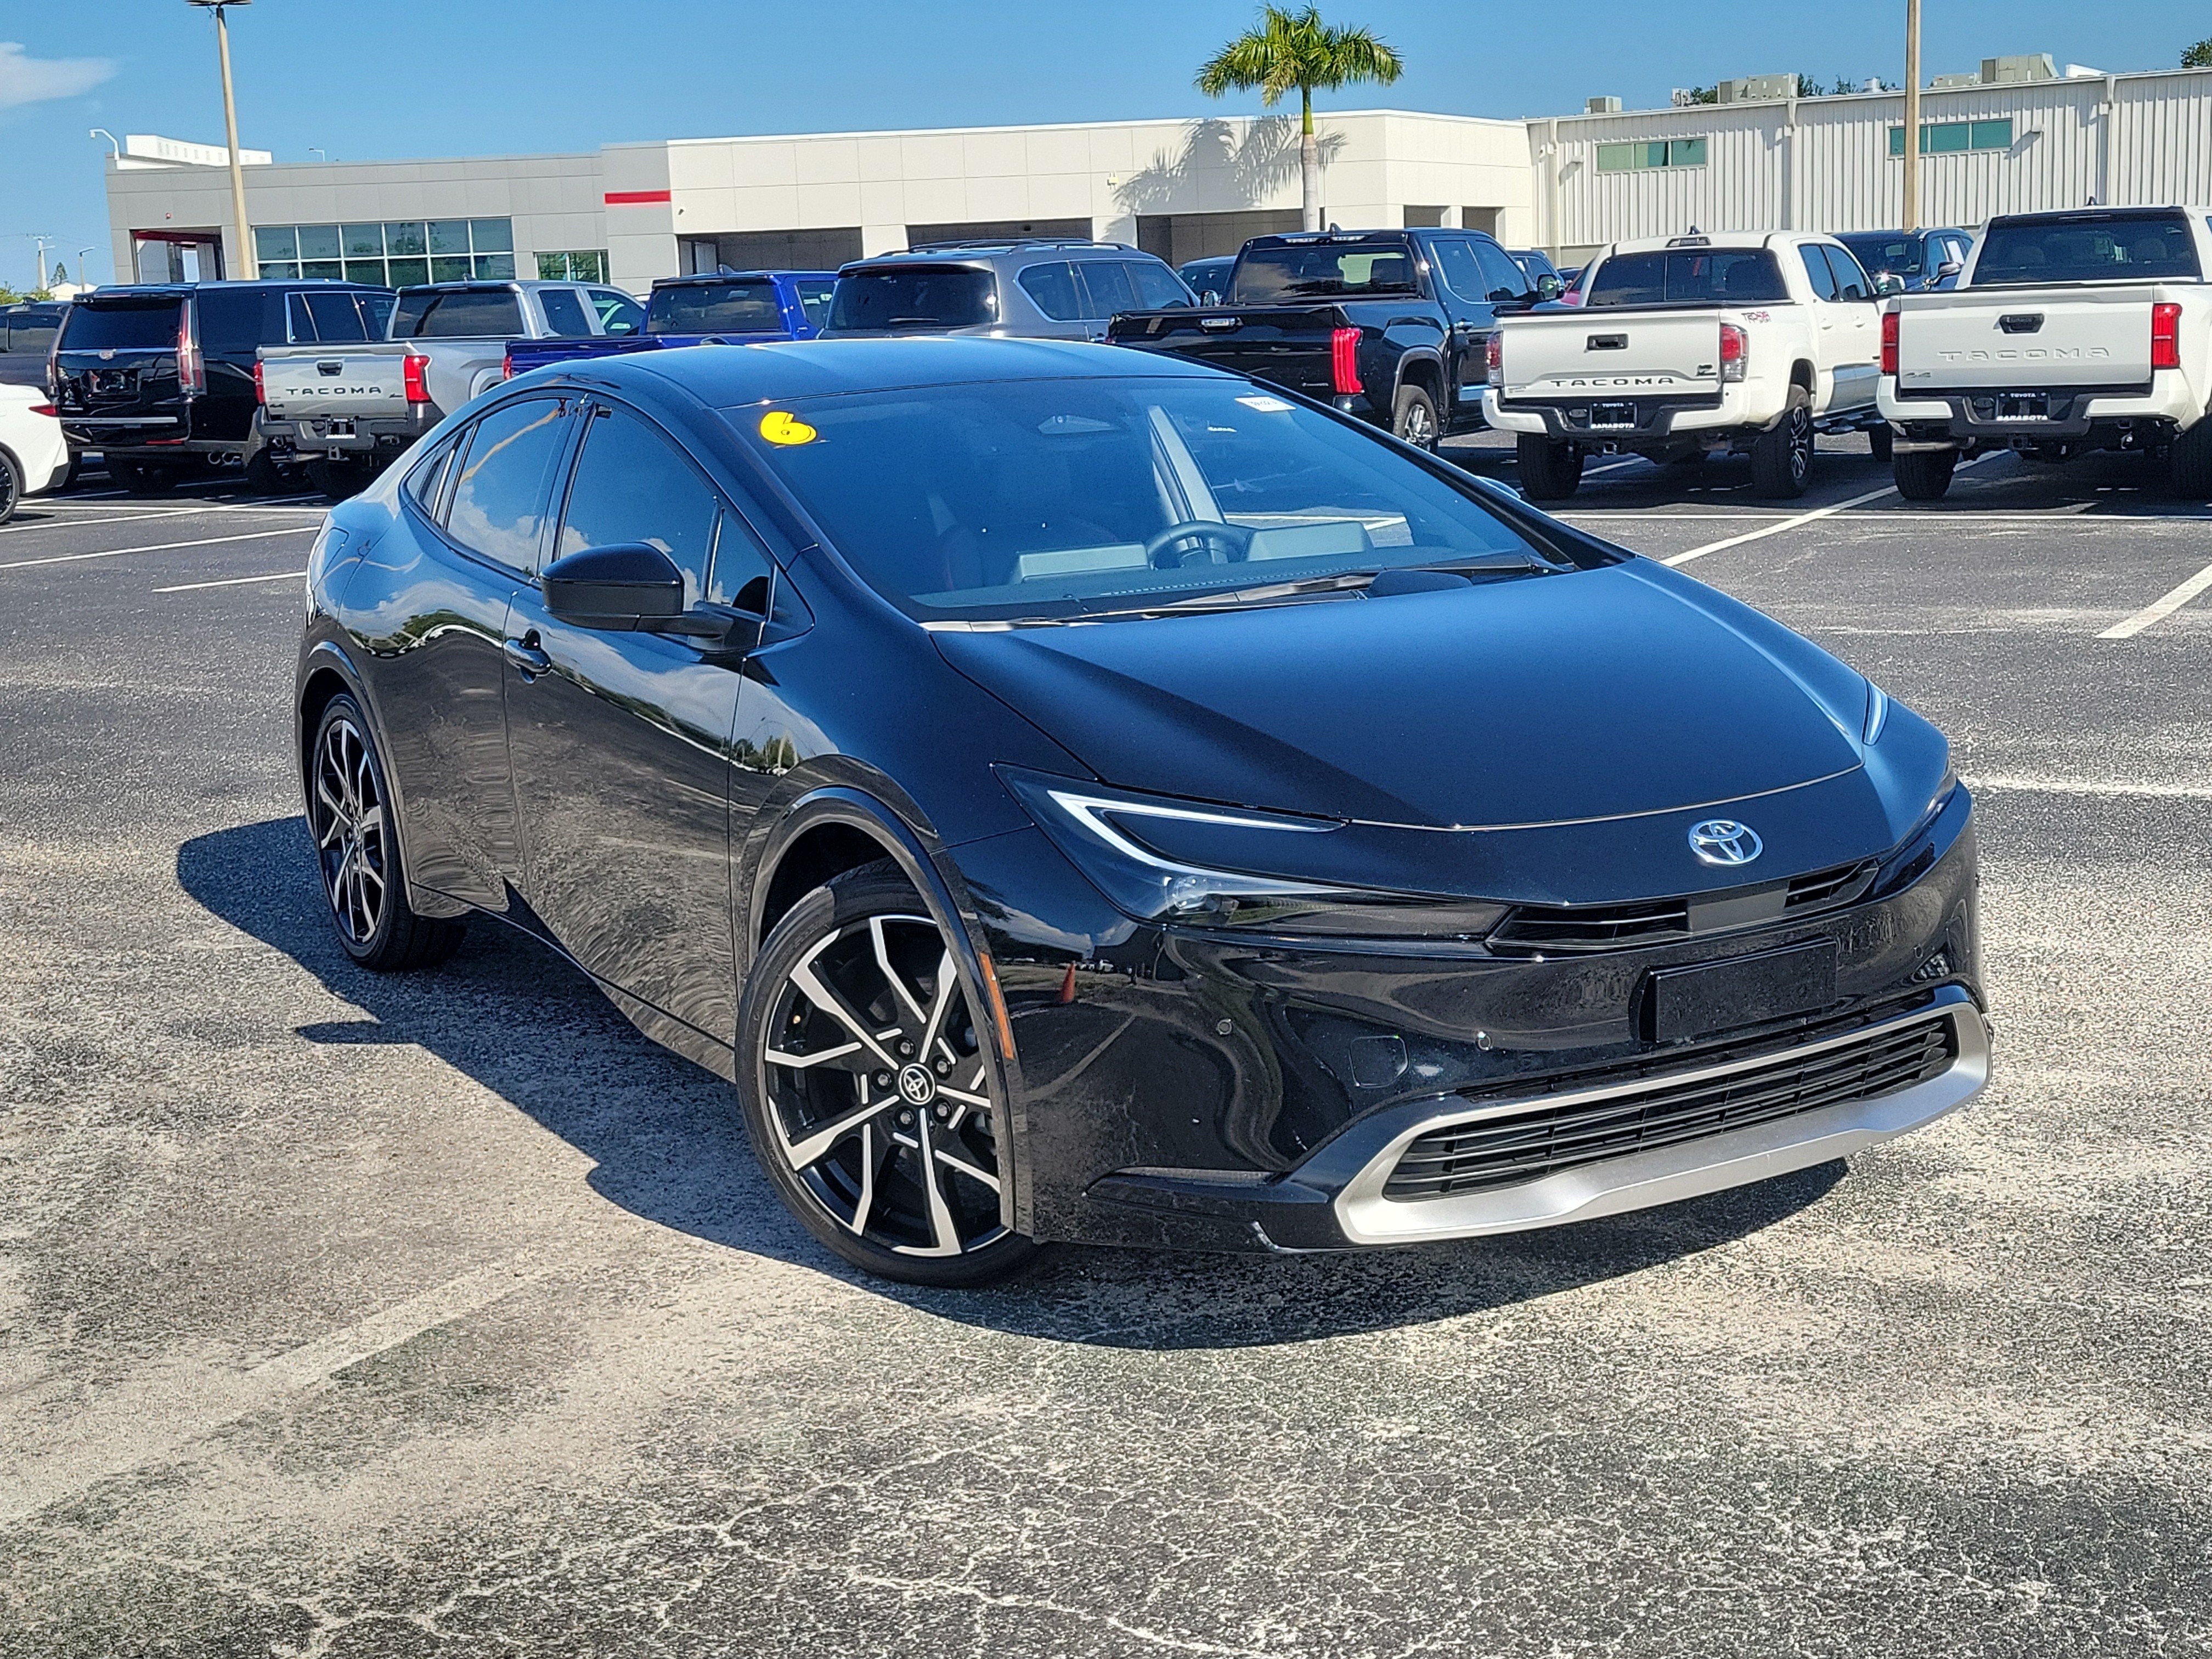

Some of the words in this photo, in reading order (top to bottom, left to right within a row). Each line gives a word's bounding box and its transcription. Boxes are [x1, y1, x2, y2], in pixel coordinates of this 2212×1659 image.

[1937, 347, 2109, 362] TACOMA
[1550, 377, 1674, 387] TACOMA
[286, 386, 382, 396] TACOMA
[760, 411, 817, 445] 6
